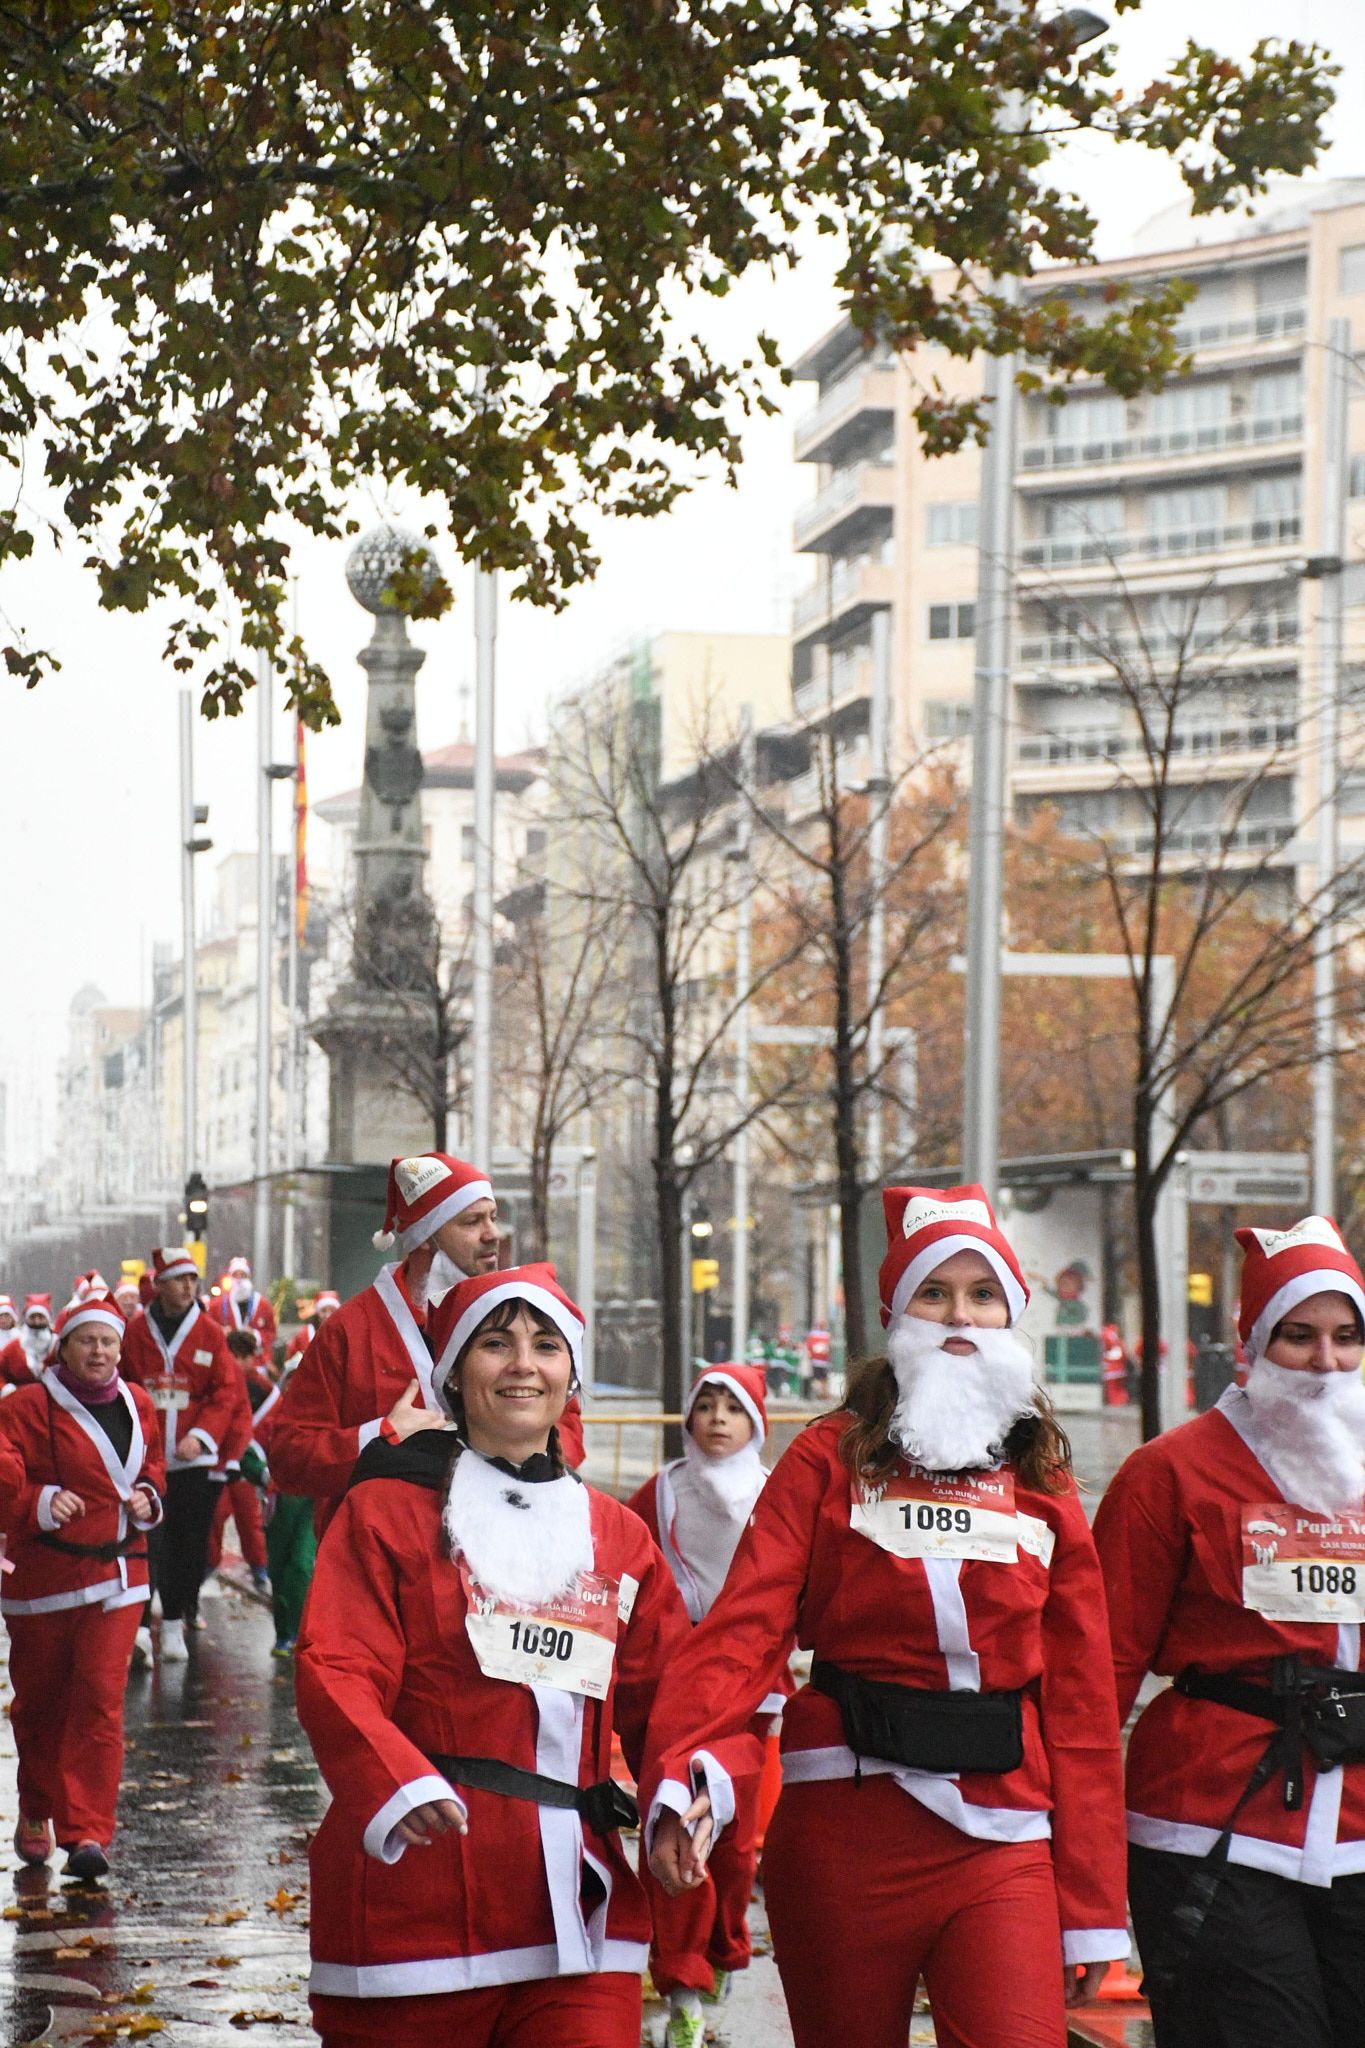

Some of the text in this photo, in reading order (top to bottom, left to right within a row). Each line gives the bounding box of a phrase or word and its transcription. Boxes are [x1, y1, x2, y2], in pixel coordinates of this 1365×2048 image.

[906, 1210, 937, 1228] CAJA
[932, 1487, 982, 1503] CAJA RURAL
[965, 1475, 1004, 1497] Noel
[899, 1503, 971, 1534] 1089
[1291, 1565, 1356, 1595] 1088
[562, 1606, 588, 1617] RURAL
[510, 1621, 574, 1662] 1090
